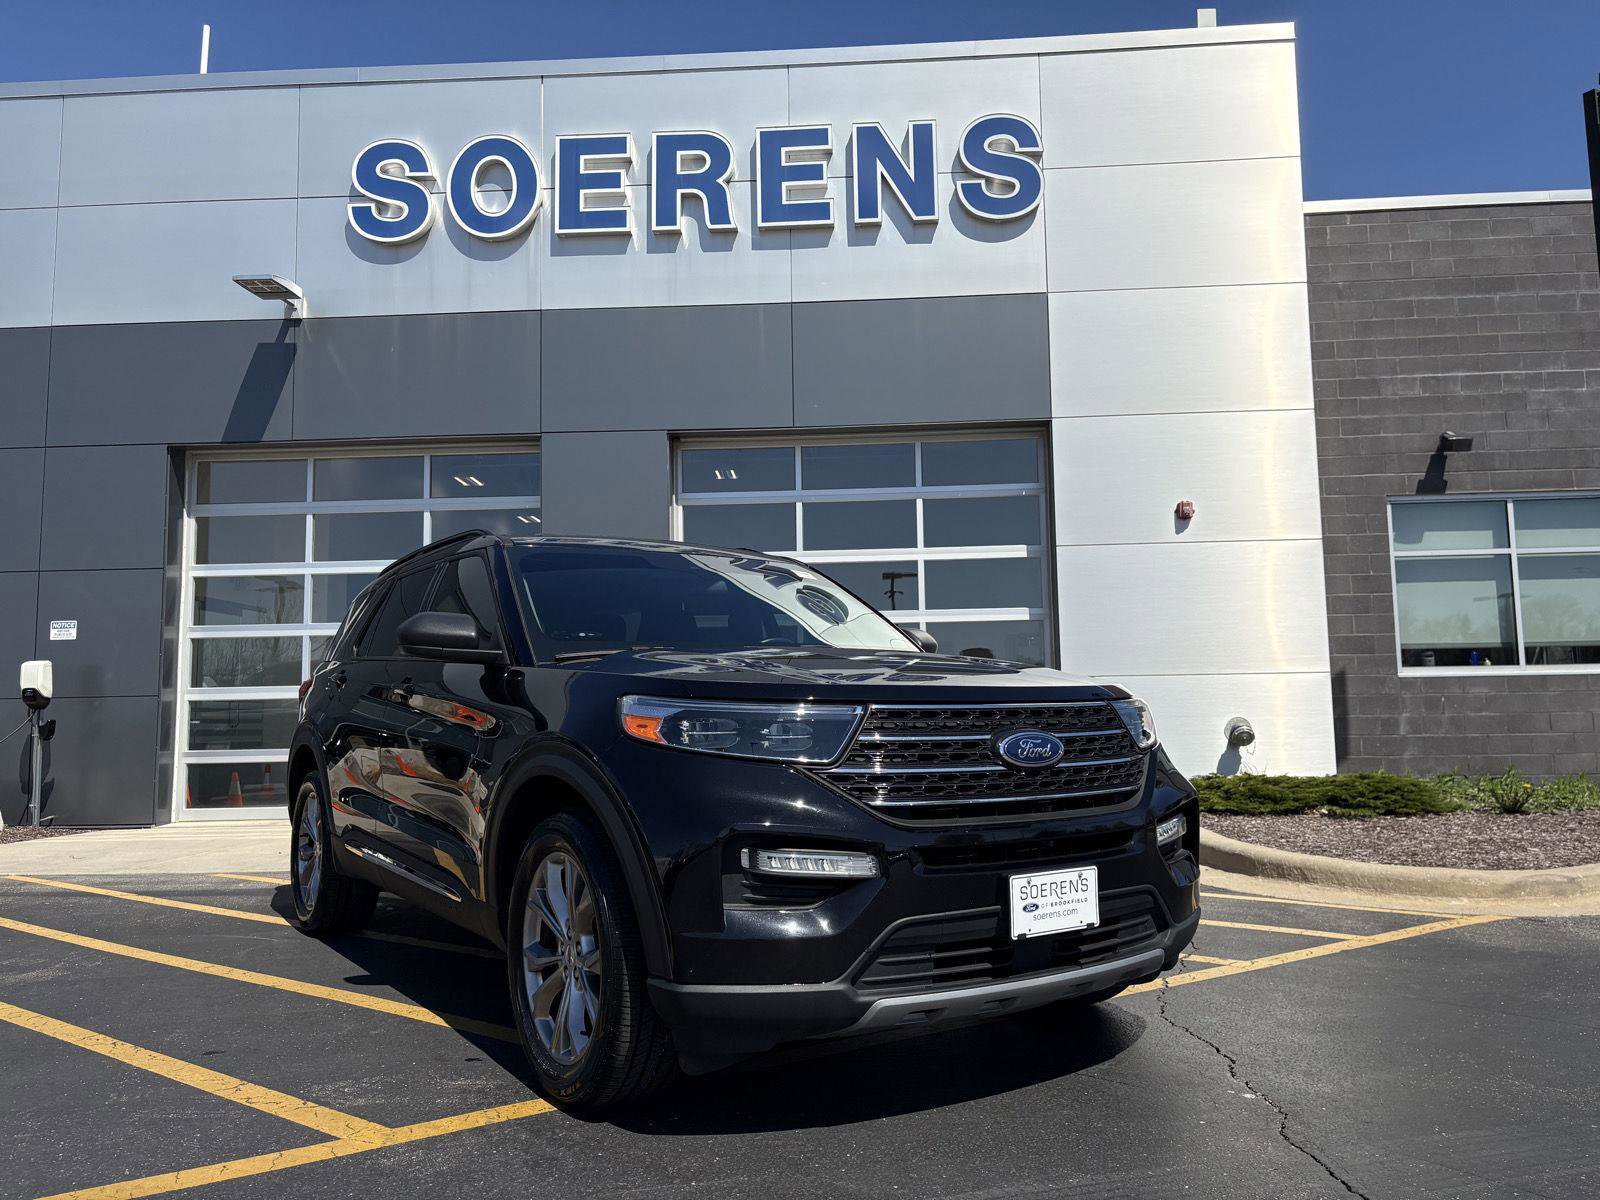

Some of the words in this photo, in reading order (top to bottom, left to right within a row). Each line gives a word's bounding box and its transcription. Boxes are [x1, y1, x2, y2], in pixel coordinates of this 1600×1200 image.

[346, 113, 1044, 246] SOERENS
[1018, 738, 1052, 758] Ford
[1020, 877, 1089, 900] SOERENS
[1050, 897, 1088, 908] BROOKFIELD
[1033, 908, 1079, 921] soerens.com
